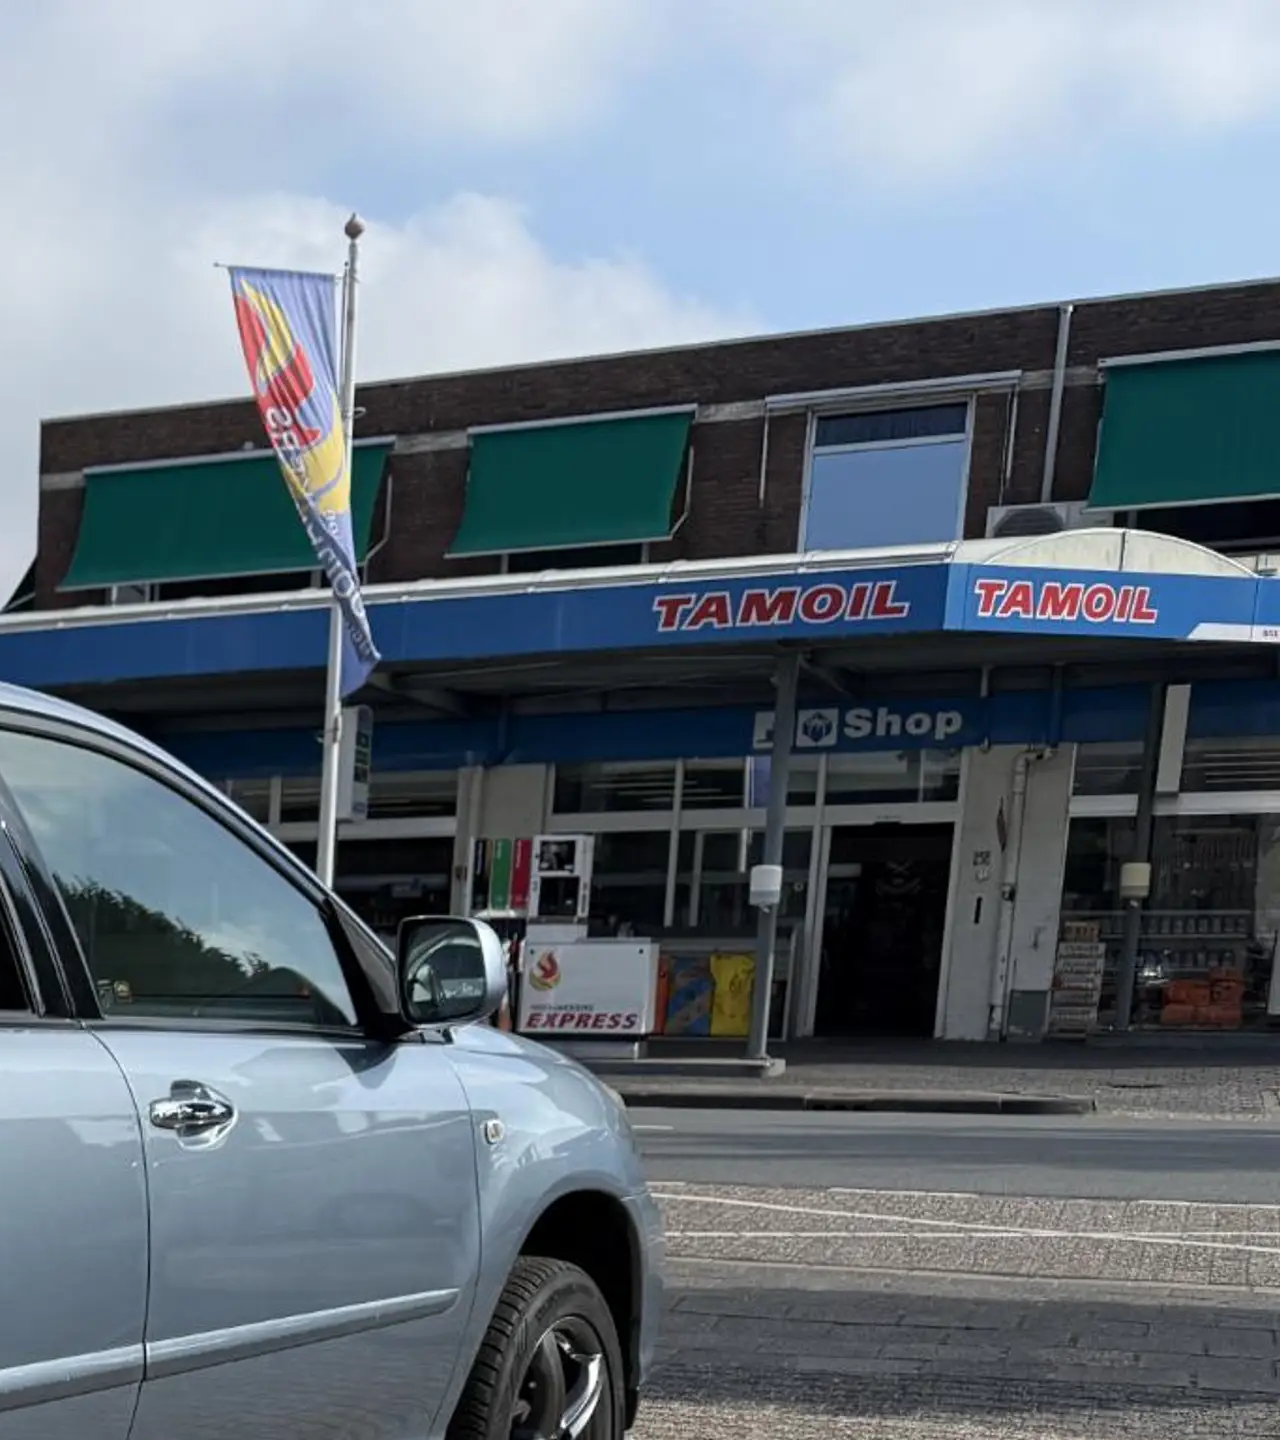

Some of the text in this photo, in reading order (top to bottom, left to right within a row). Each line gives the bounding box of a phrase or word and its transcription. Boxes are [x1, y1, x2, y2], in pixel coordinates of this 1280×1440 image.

[653, 580, 910, 632] TAMOIL
[974, 579, 1159, 624] TAMOIL
[843, 706, 963, 741] Shop
[526, 1012, 638, 1030] EXPRESS
